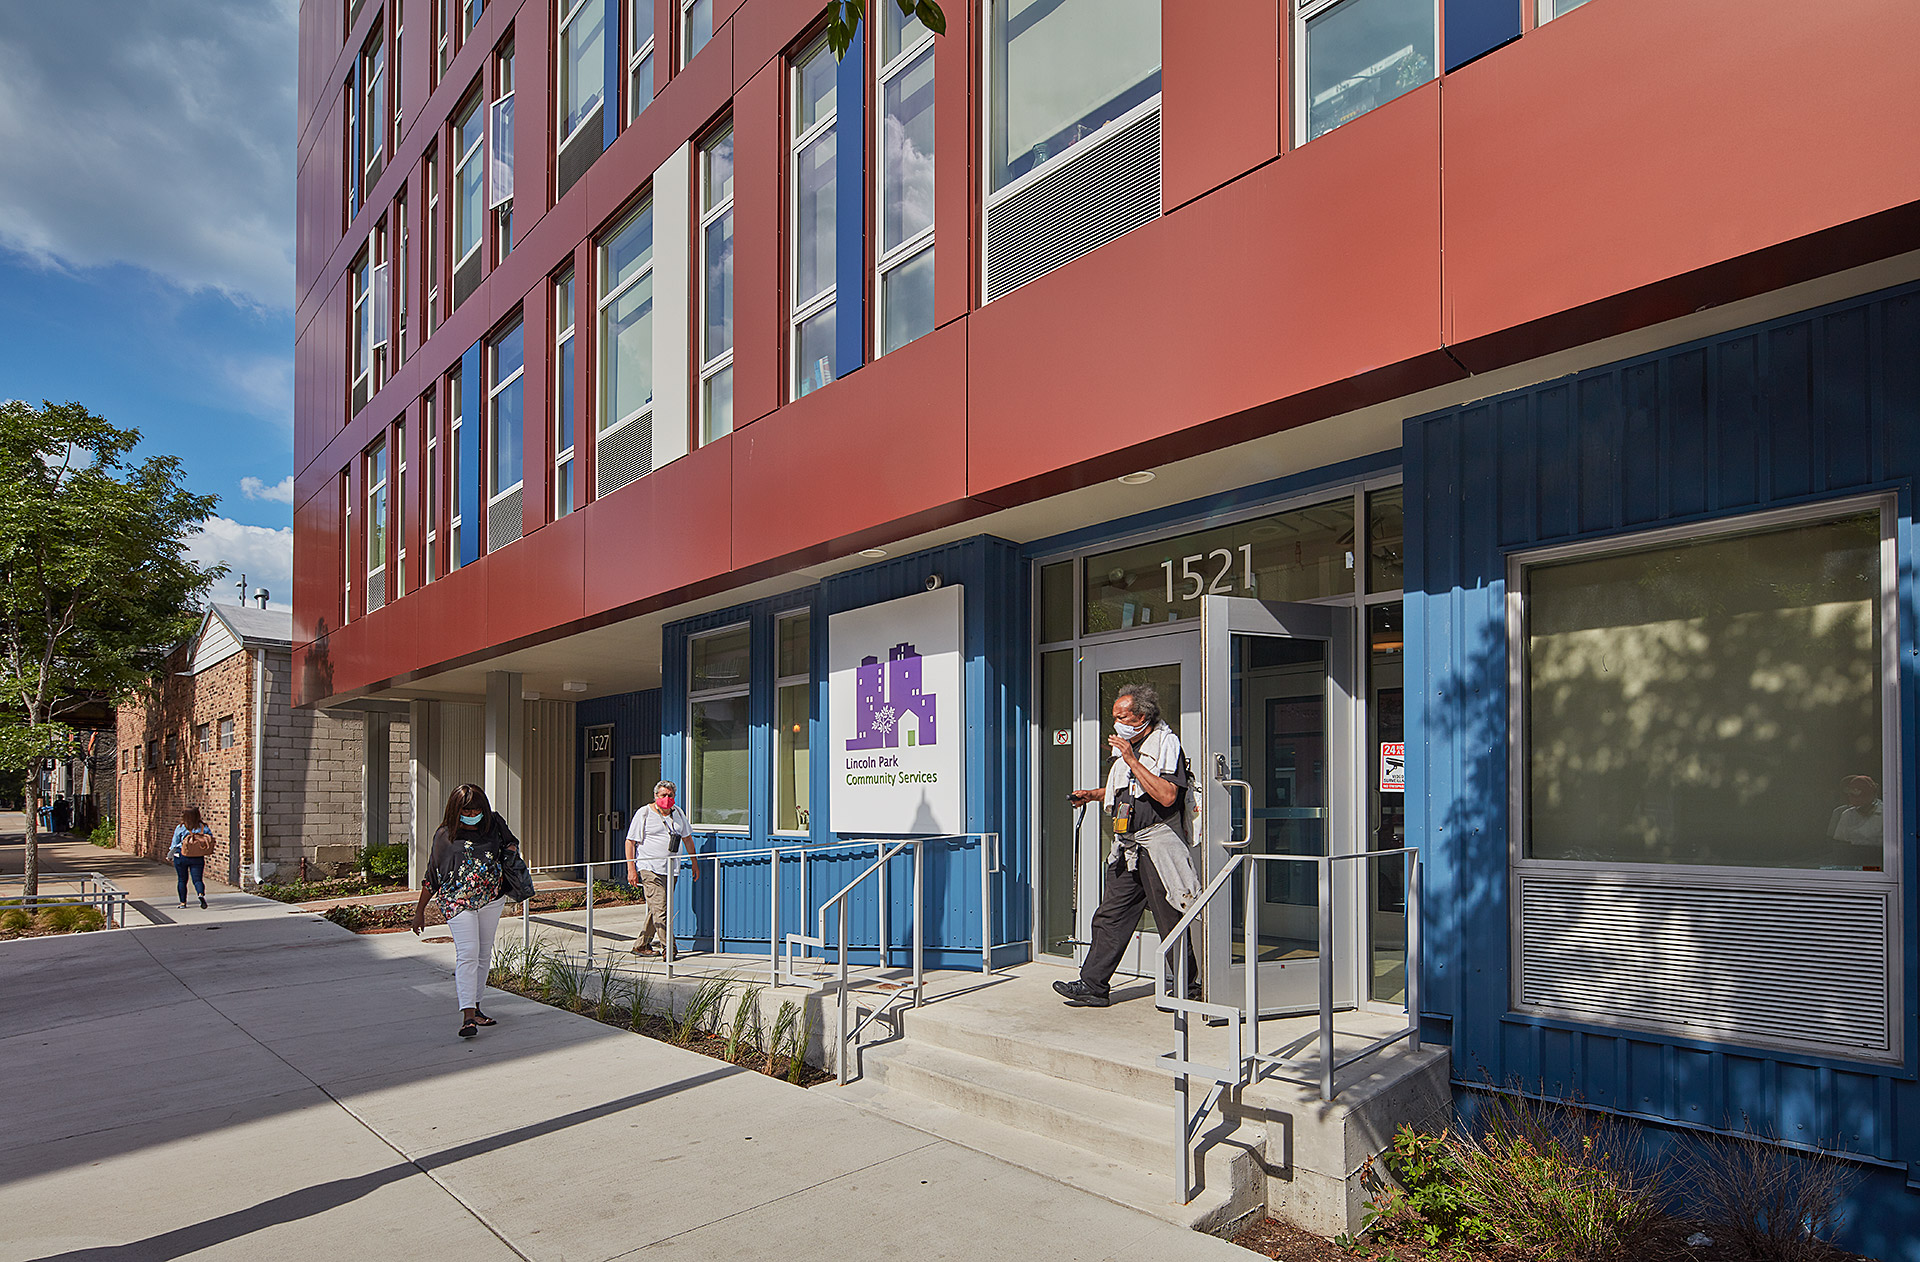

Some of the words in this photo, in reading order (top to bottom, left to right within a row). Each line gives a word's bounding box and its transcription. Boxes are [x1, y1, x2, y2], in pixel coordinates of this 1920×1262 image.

[1160, 543, 1251, 603] 1521
[591, 734, 609, 751] 1527
[1384, 745, 1396, 755] 24
[846, 756, 876, 769] Lincoln
[879, 754, 899, 767] Park
[846, 772, 896, 786] Community
[898, 771, 938, 783] Services
